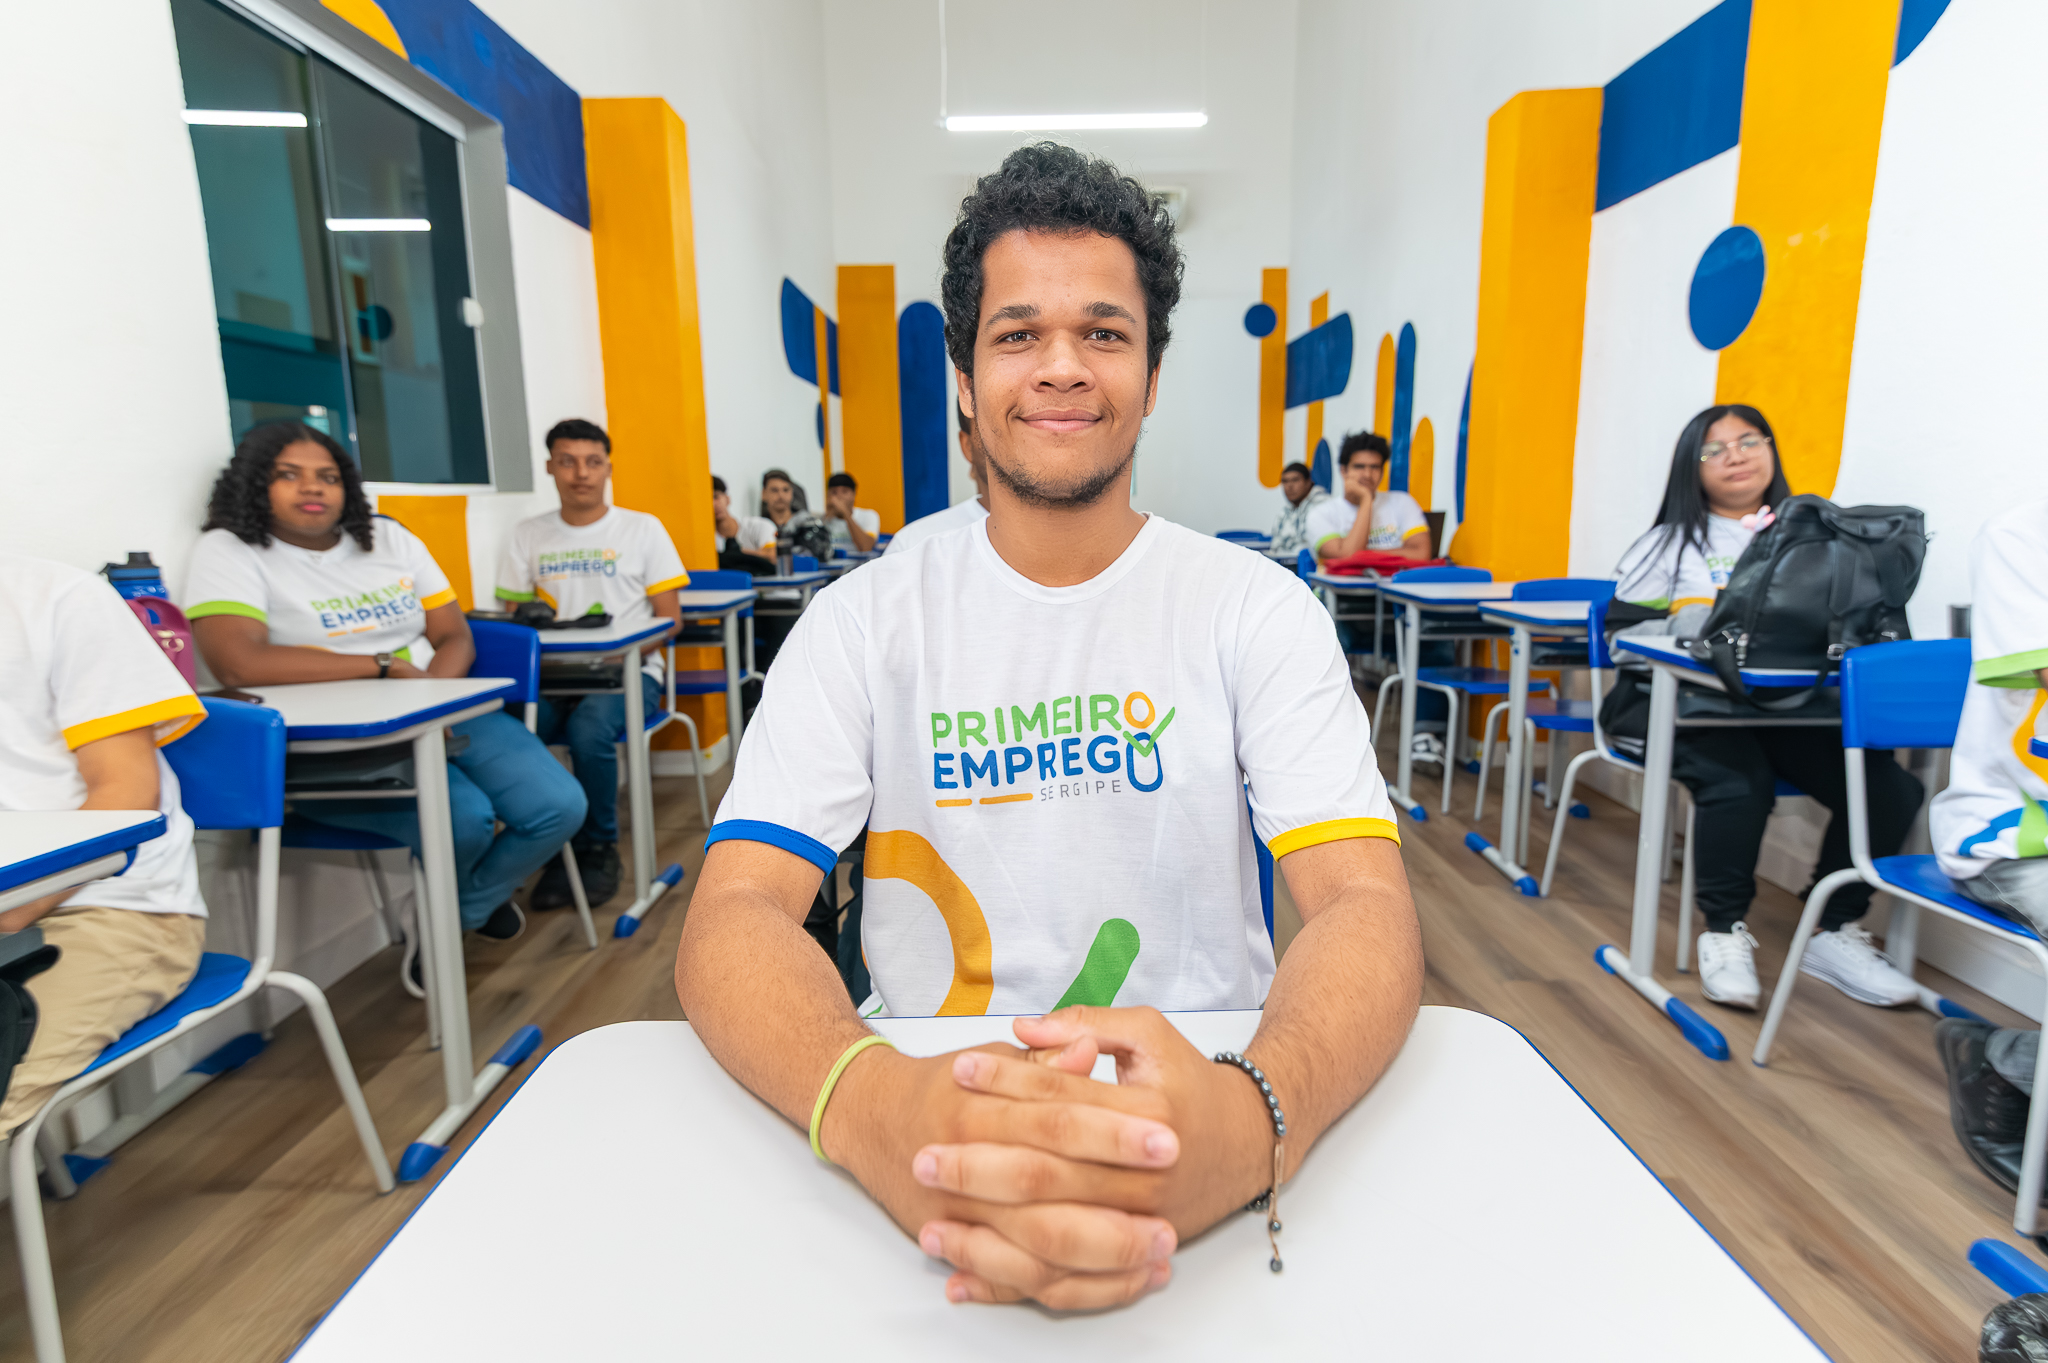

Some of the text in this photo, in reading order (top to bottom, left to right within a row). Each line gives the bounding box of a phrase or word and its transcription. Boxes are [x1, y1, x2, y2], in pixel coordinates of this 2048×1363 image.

[310, 577, 414, 612] PRIMEIRO
[931, 691, 1156, 748] PRIMEIRO
[933, 731, 1164, 793] EMPREGO
[1040, 779, 1122, 802] SERGIPE
